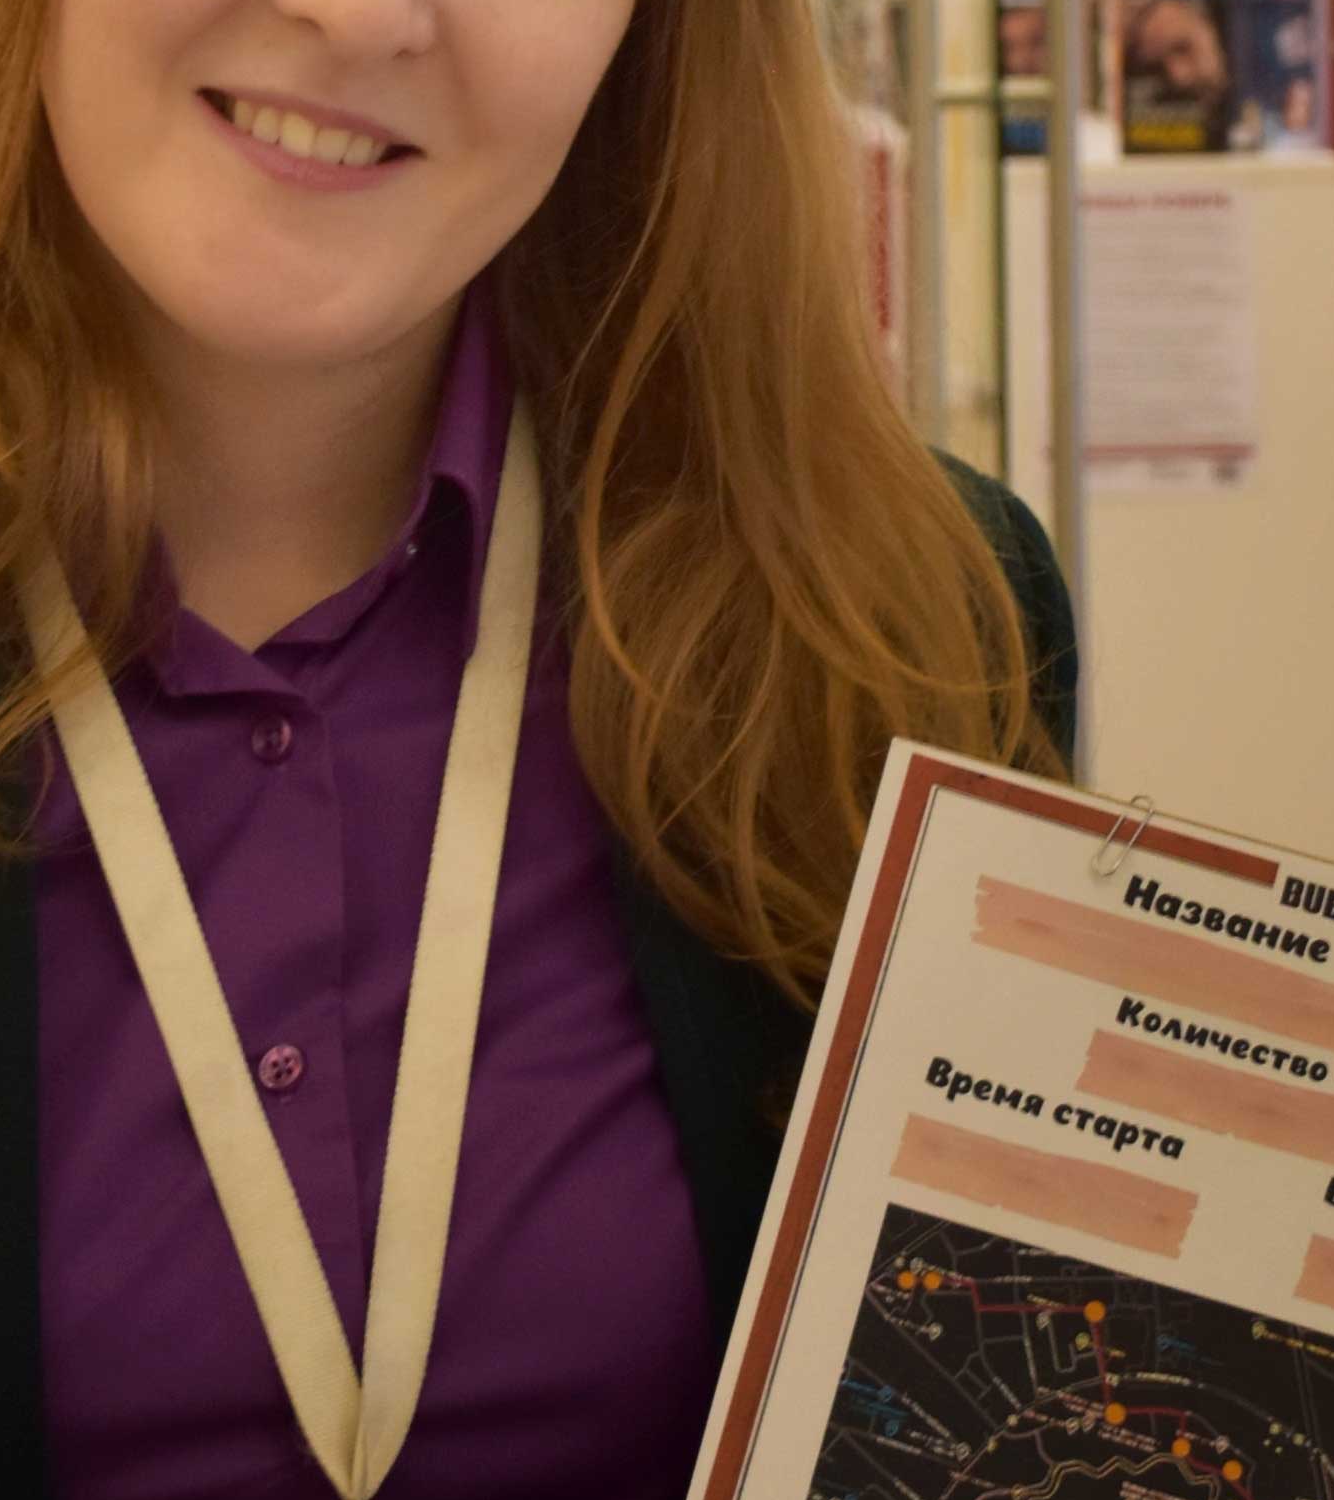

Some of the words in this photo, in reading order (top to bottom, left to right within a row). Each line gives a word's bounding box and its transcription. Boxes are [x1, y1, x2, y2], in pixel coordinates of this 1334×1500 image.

[1123, 874, 1330, 964] Название
[1116, 996, 1329, 1082] Количество
[925, 1057, 1045, 1117] Время
[1052, 1103, 1185, 1160] старта
